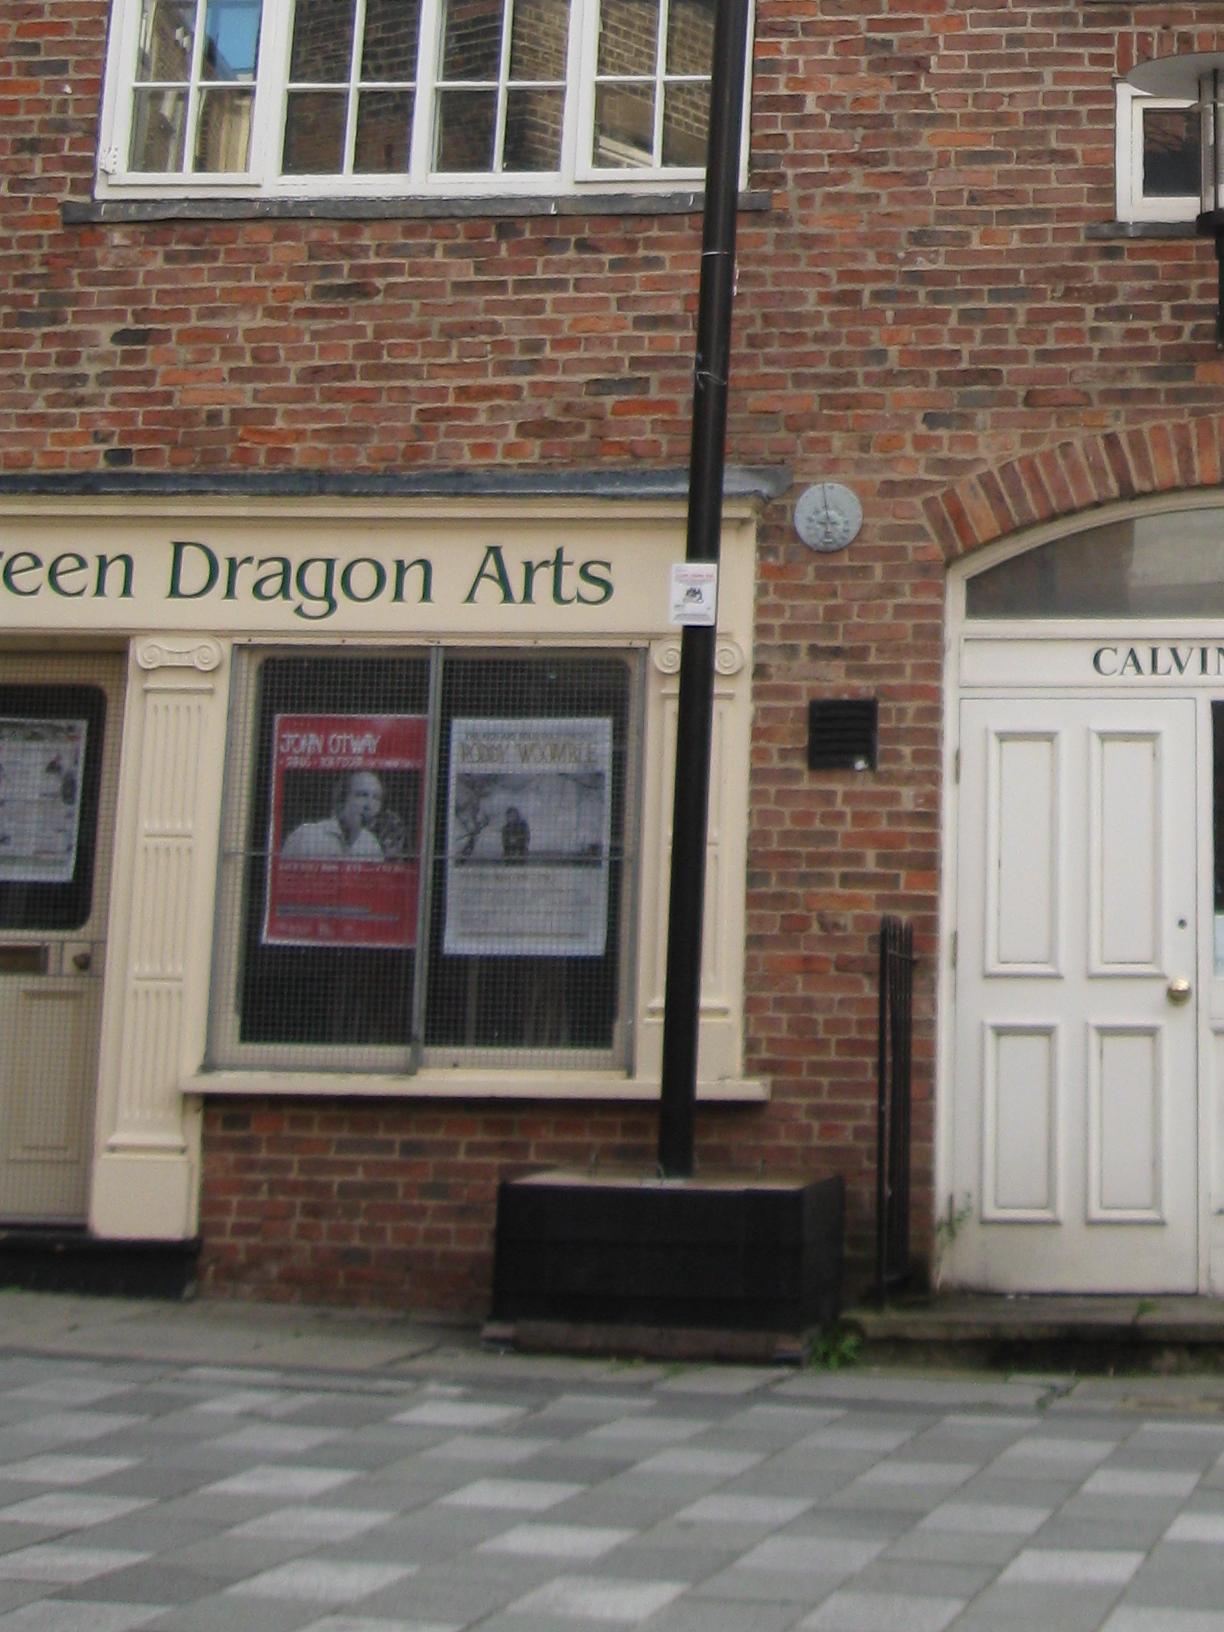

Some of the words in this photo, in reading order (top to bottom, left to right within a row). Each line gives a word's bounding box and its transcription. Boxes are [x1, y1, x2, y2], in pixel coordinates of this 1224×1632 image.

[0, 551, 134, 597] een
[165, 541, 435, 620] Dragon
[462, 545, 615, 606] Arts
[328, 733, 381, 754] OTWAY
